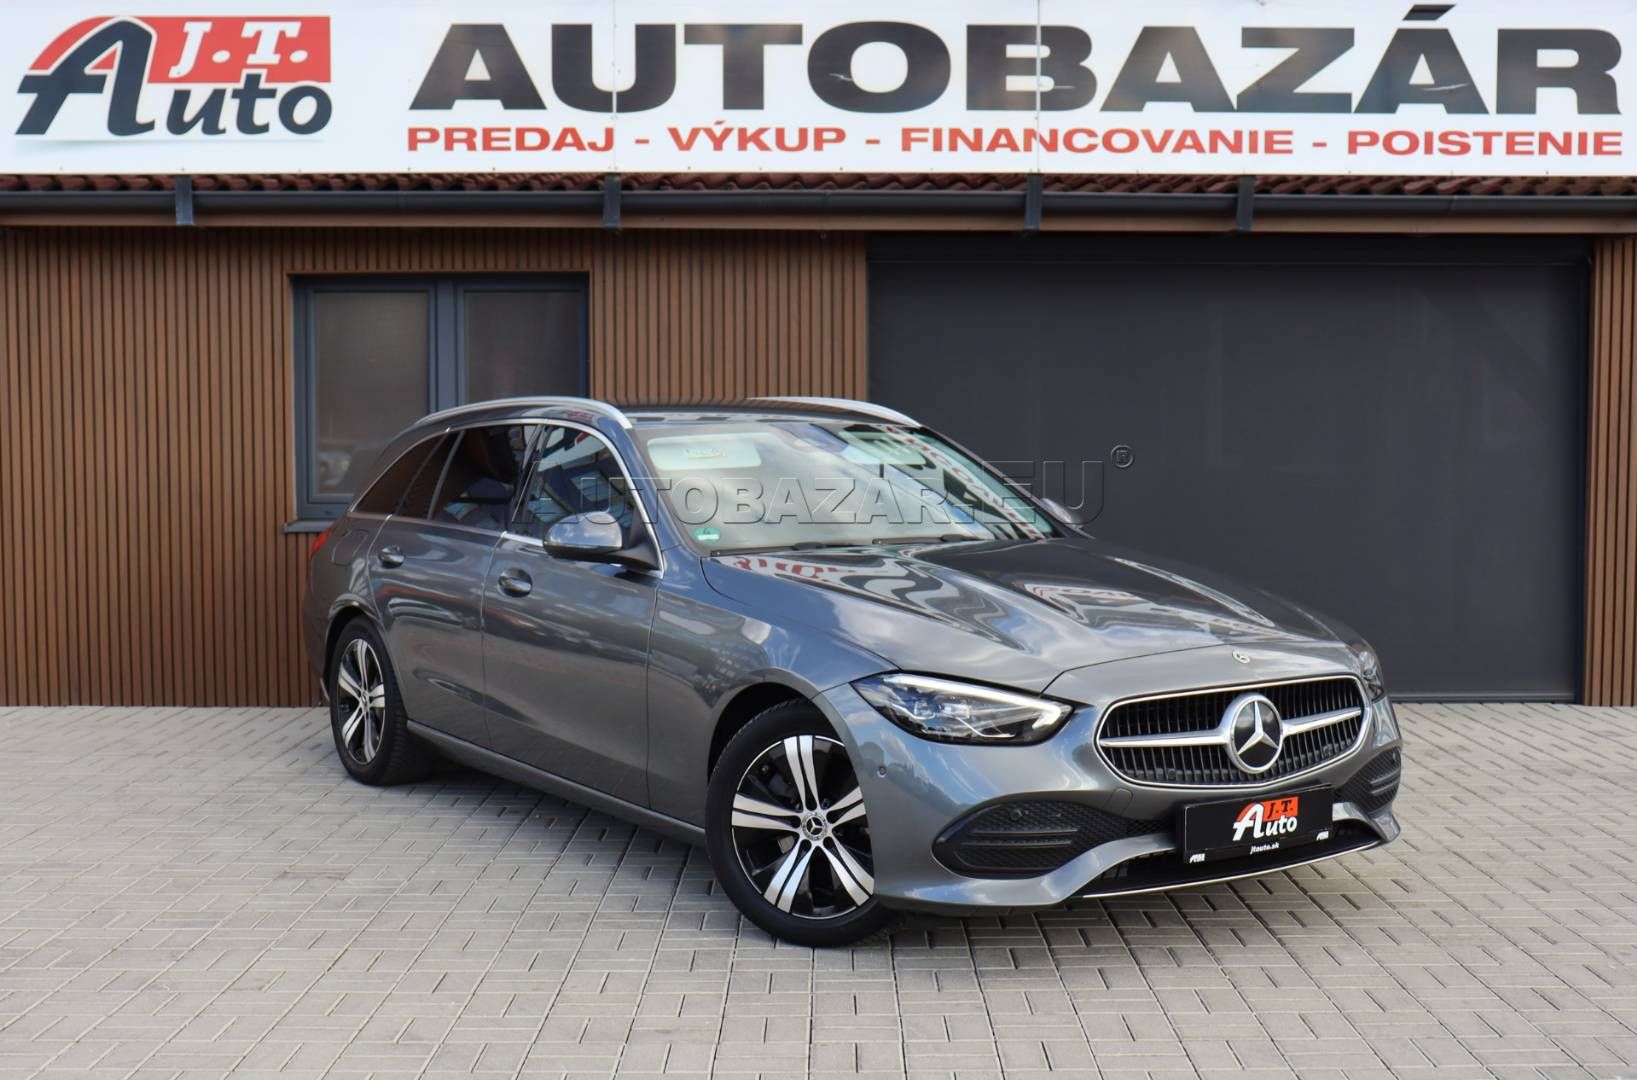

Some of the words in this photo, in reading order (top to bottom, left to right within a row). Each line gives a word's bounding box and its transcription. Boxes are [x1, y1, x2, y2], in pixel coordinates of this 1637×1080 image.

[168, 21, 308, 79] J.T.
[408, 4, 1623, 115] AUTOBAZÁR
[15, 18, 333, 137] Auto
[407, 126, 615, 152] PREDAJ
[668, 120, 846, 152] VÝKUP
[901, 127, 1293, 154] FINANCOVANIE
[1347, 130, 1622, 155] POISTENIE
[1232, 803, 1298, 841] Auto
[1267, 799, 1294, 819] J.T.
